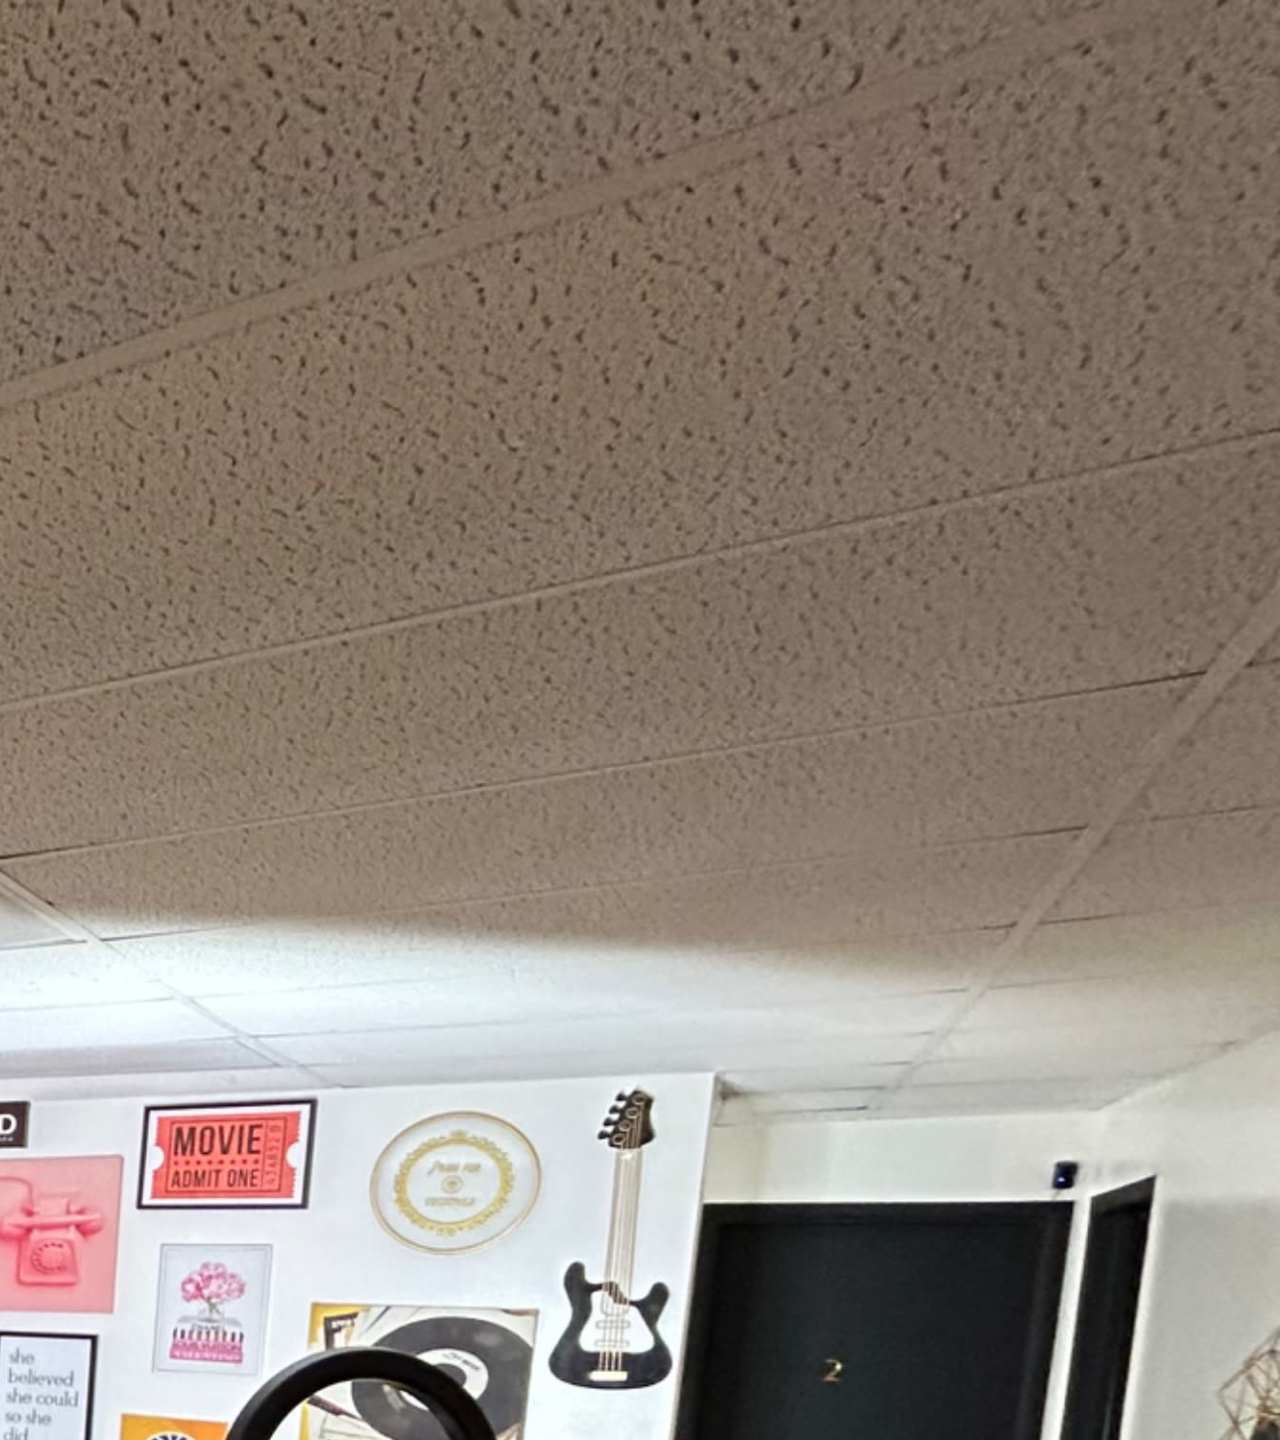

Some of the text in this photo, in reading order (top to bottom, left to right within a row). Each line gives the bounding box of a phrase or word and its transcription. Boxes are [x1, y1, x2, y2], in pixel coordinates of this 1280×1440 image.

[173, 1123, 264, 1156] MOVIE
[171, 1168, 260, 1188] ADMIT ONE
[9, 1347, 35, 1365] she
[7, 1367, 74, 1387] believed
[822, 1358, 843, 1383] 2
[6, 1387, 79, 1407] she could
[5, 1408, 52, 1425] so she
